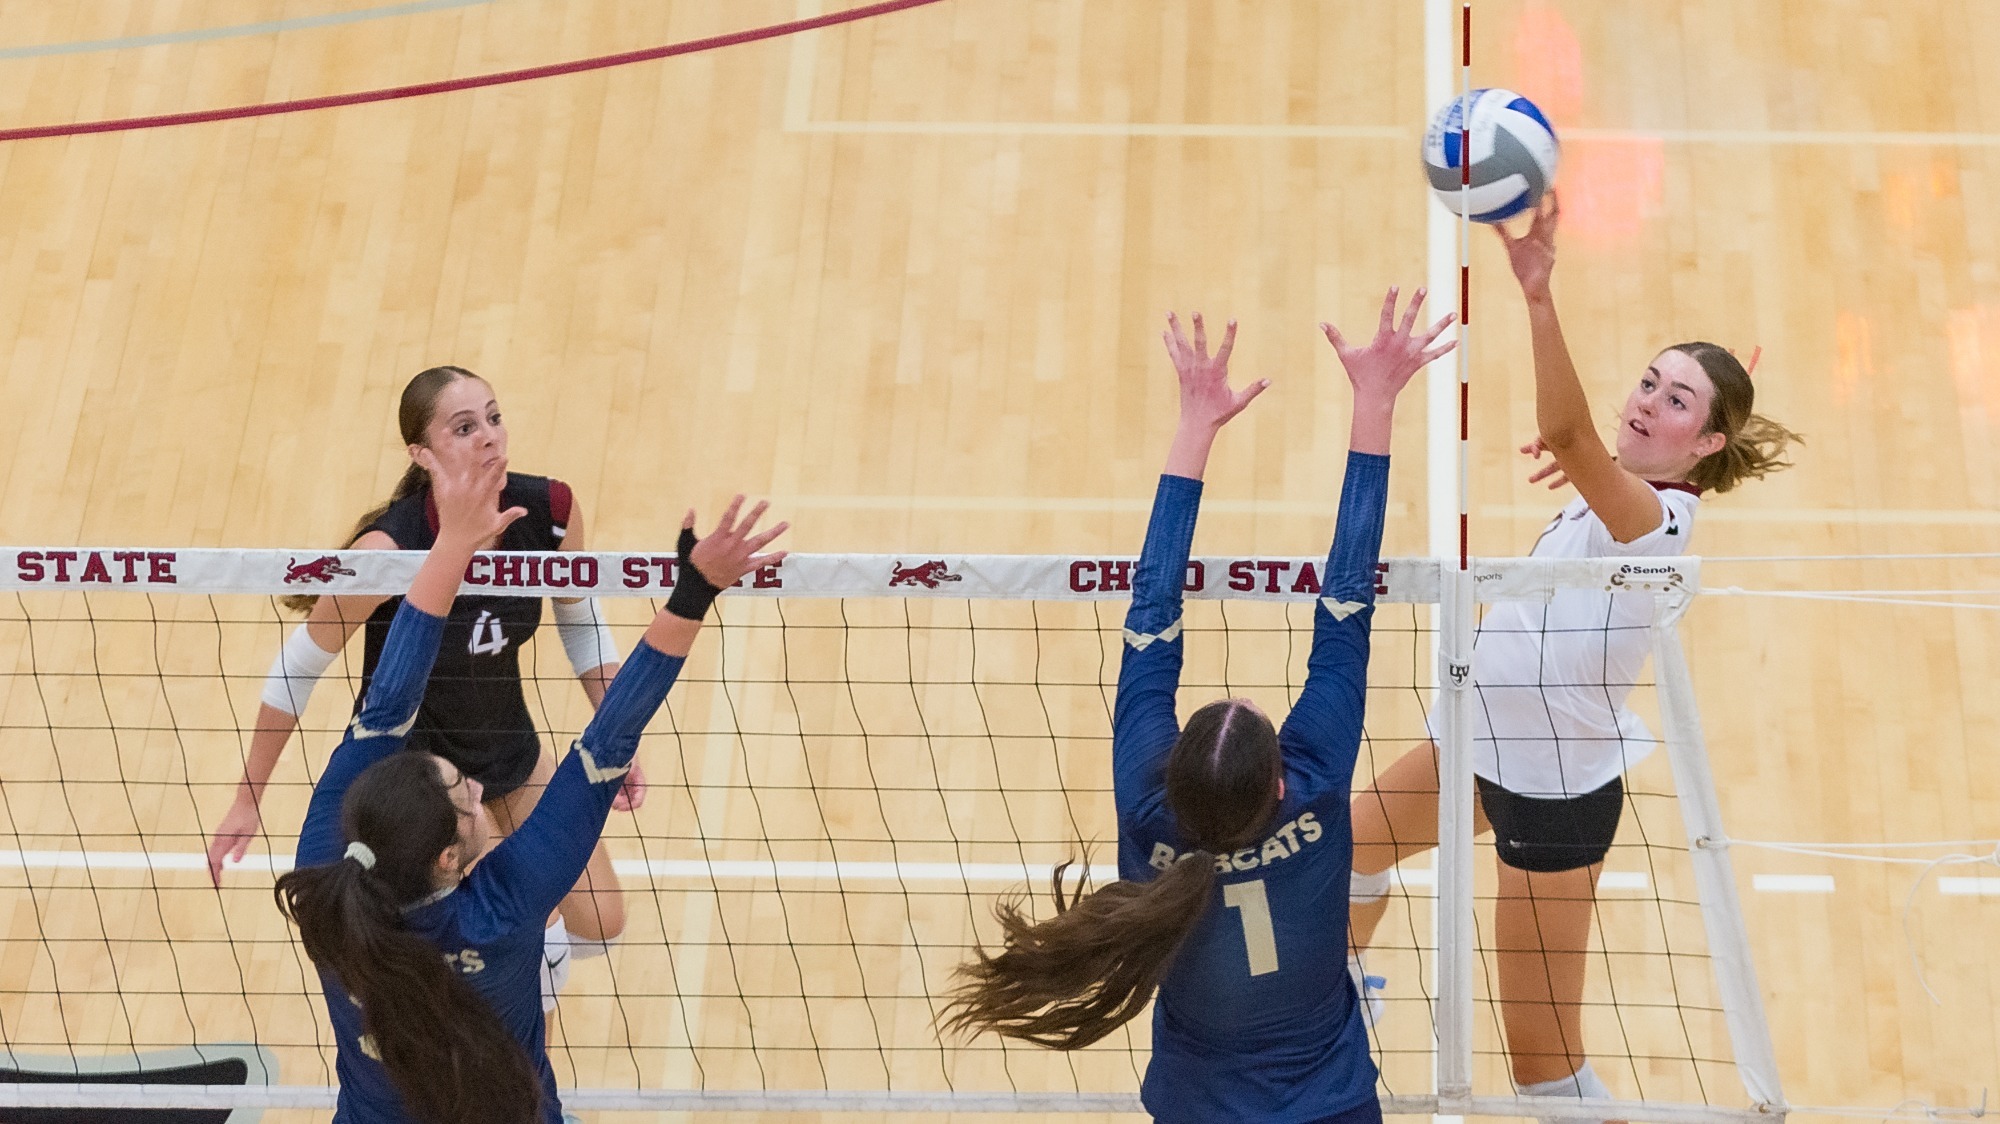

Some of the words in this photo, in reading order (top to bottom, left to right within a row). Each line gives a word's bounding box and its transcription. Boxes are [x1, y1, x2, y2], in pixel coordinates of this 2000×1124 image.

[17, 551, 177, 583] STATE
[464, 555, 599, 588] CHICO
[622, 556, 783, 588] STE
[1070, 560, 1205, 592] CHO
[1228, 561, 1389, 595] STA
[1633, 566, 1676, 574] Senoh
[468, 610, 509, 656] 4
[1149, 812, 1323, 875] BBCATS
[1223, 879, 1279, 976] 1
